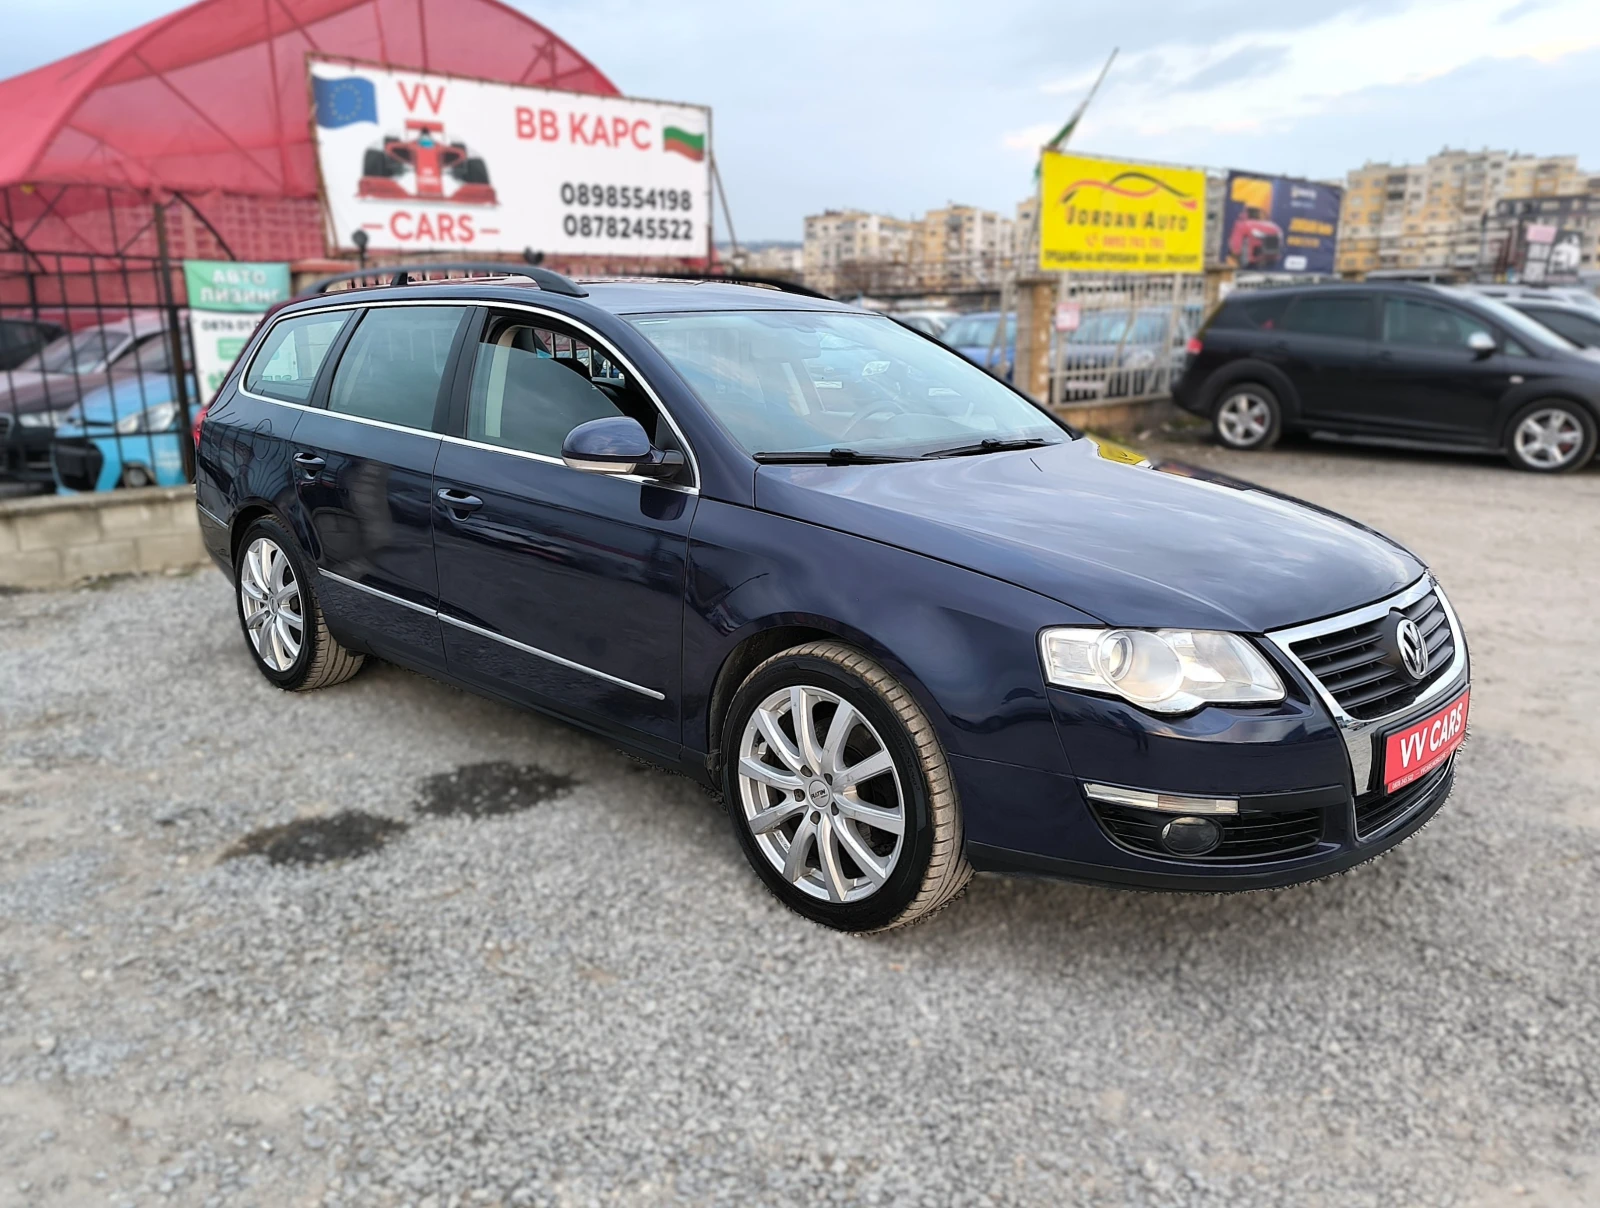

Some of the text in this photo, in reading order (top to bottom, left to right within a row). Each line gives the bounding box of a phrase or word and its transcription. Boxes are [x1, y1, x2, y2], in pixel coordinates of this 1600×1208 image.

[397, 81, 445, 115] VV
[569, 112, 652, 151] КАРС
[560, 182, 692, 211] 0898554198
[389, 211, 475, 243] CARS
[563, 214, 693, 240] 0878245522
[212, 269, 267, 286] АВТО
[1400, 727, 1429, 768] VV
[1429, 702, 1463, 752] CARS
